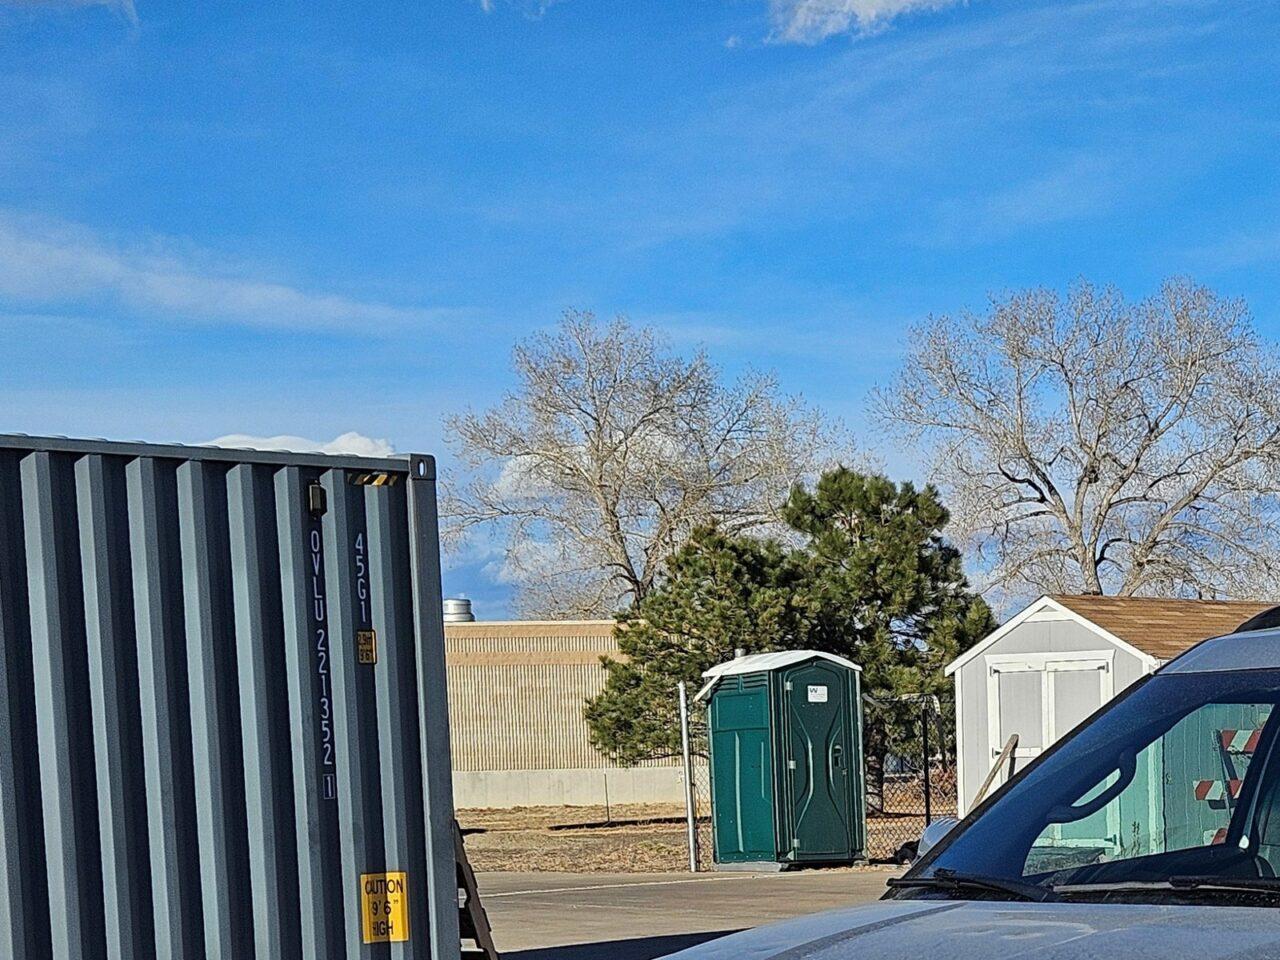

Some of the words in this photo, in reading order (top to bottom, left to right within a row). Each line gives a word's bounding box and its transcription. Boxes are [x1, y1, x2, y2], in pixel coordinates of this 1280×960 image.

[310, 530, 324, 621] OVLU
[317, 629, 333, 765] 221352
[355, 532, 367, 622] 45G1
